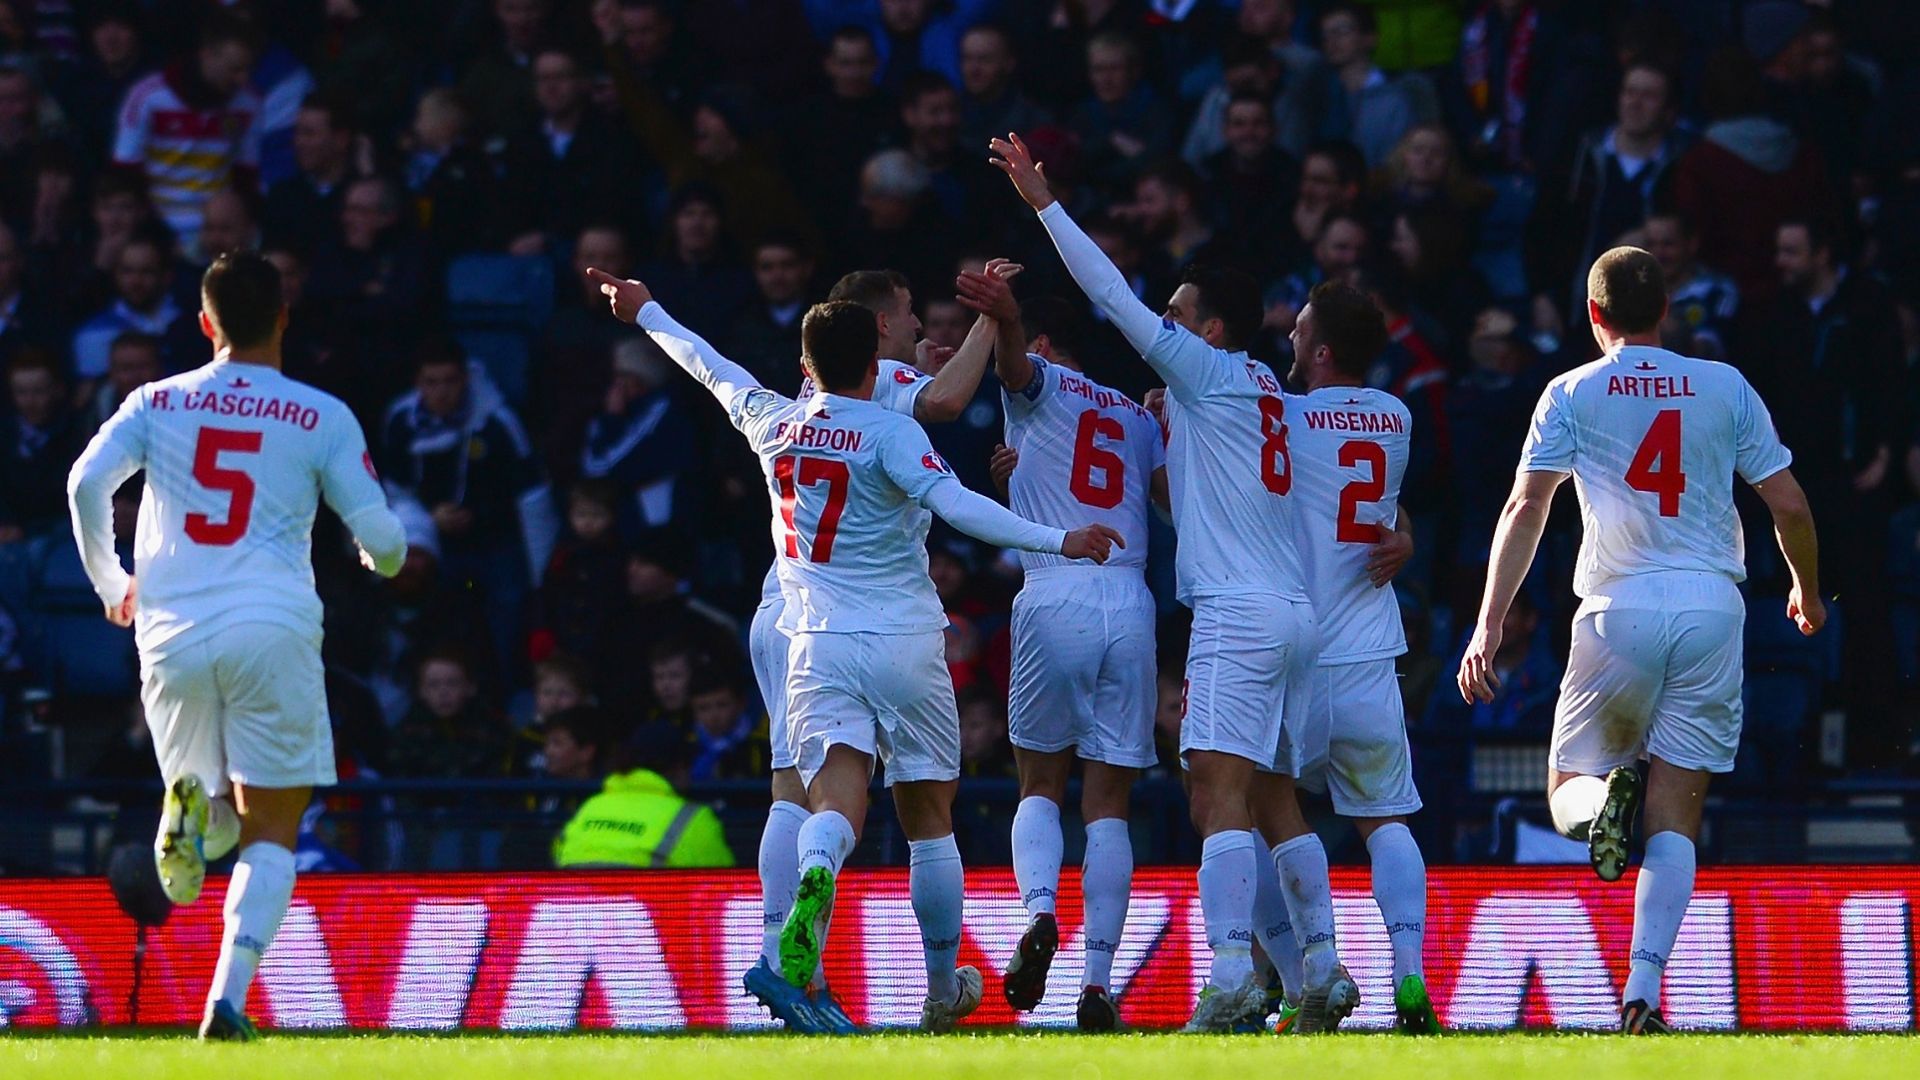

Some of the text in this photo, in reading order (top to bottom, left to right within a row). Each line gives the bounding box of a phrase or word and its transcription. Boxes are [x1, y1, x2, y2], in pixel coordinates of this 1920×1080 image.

[152, 389, 320, 431] R. CASCIARO
[1304, 411, 1404, 434] WISEMAN
[1607, 375, 1696, 398] ARTELL
[183, 425, 263, 545] 5
[1069, 408, 1125, 510] 6
[1258, 395, 1292, 497] 8
[1336, 440, 1387, 543] 2
[1624, 409, 1686, 517] 4
[773, 454, 851, 563] 17
